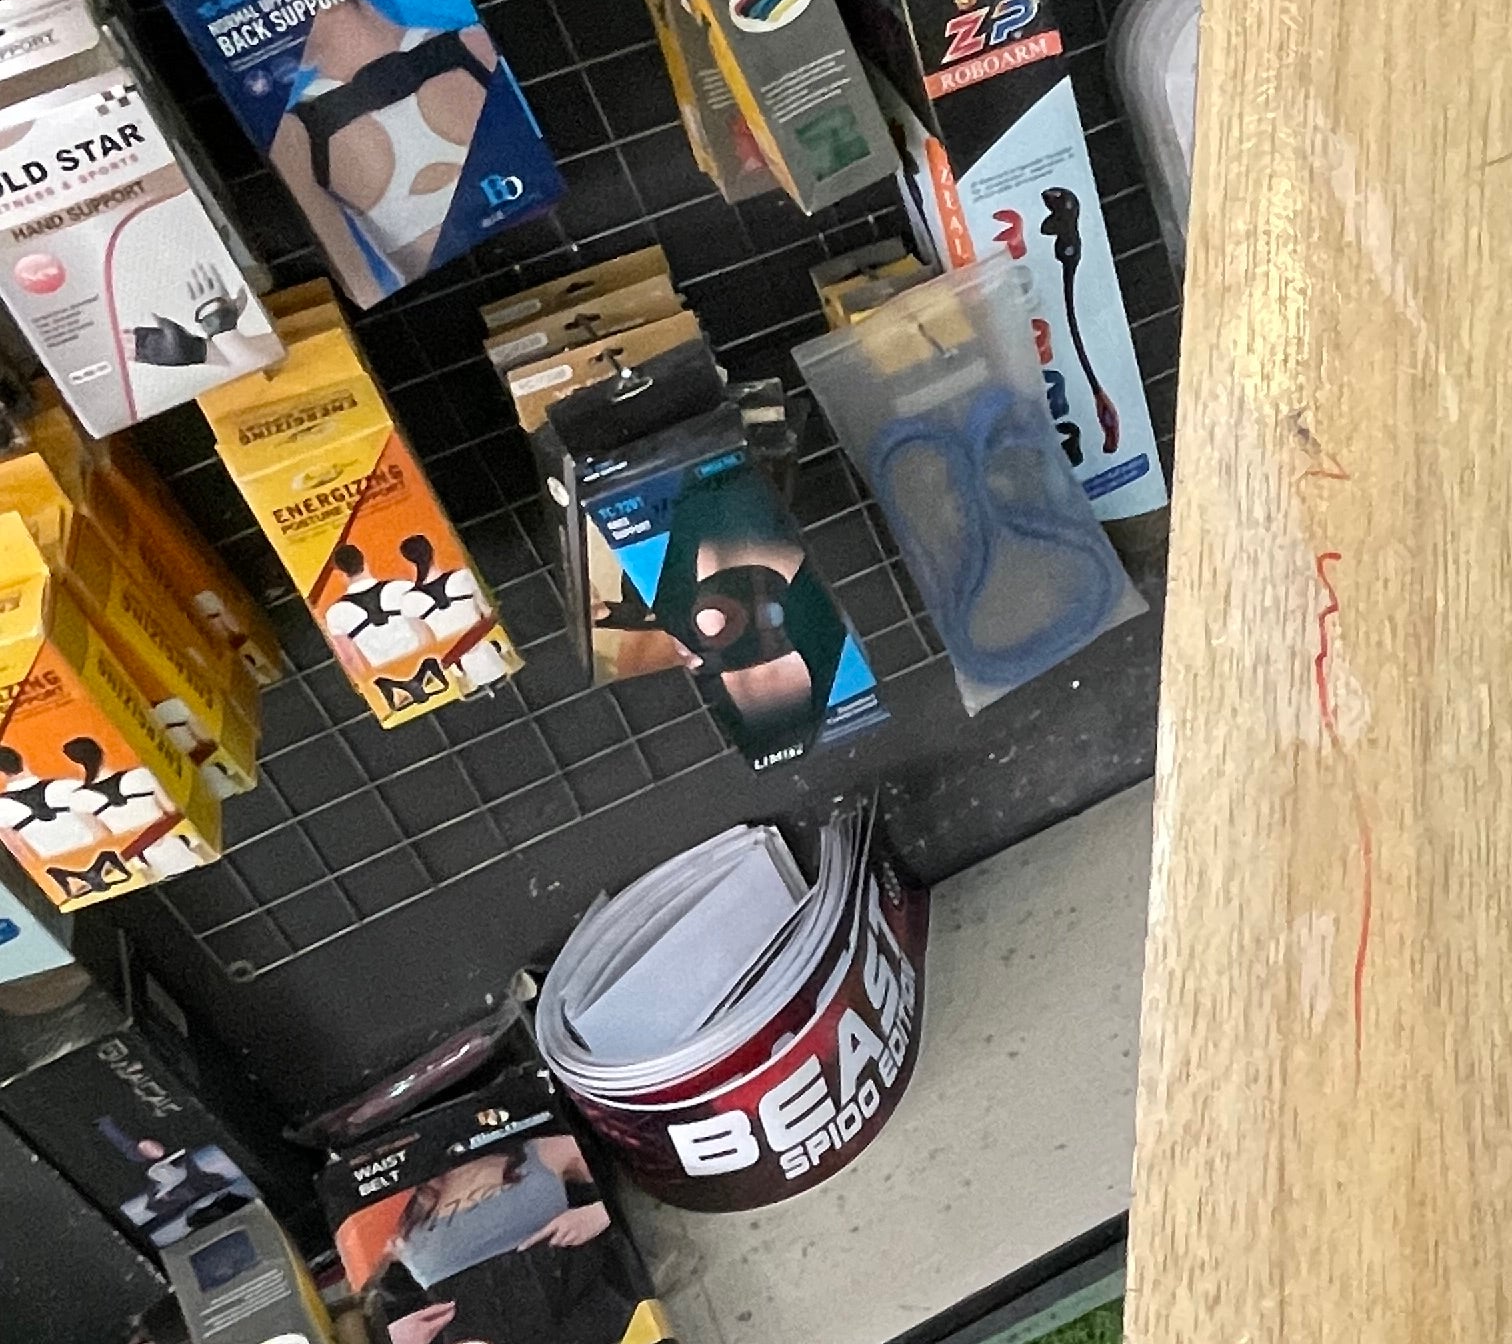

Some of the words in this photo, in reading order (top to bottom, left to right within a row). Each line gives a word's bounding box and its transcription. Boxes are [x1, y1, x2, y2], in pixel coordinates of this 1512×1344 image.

[215, 18, 272, 57] BACK
[0, 161, 48, 198] LD
[56, 123, 146, 172] STAR
[12, 213, 64, 243] HAND
[66, 180, 147, 219] SUPPORT
[272, 464, 404, 524] ENERGIZING
[667, 872, 903, 1177] BEAST
[779, 1079, 880, 1181] SPIDO
[353, 1149, 407, 1181] WAIST
[358, 1169, 400, 1197] BELT
